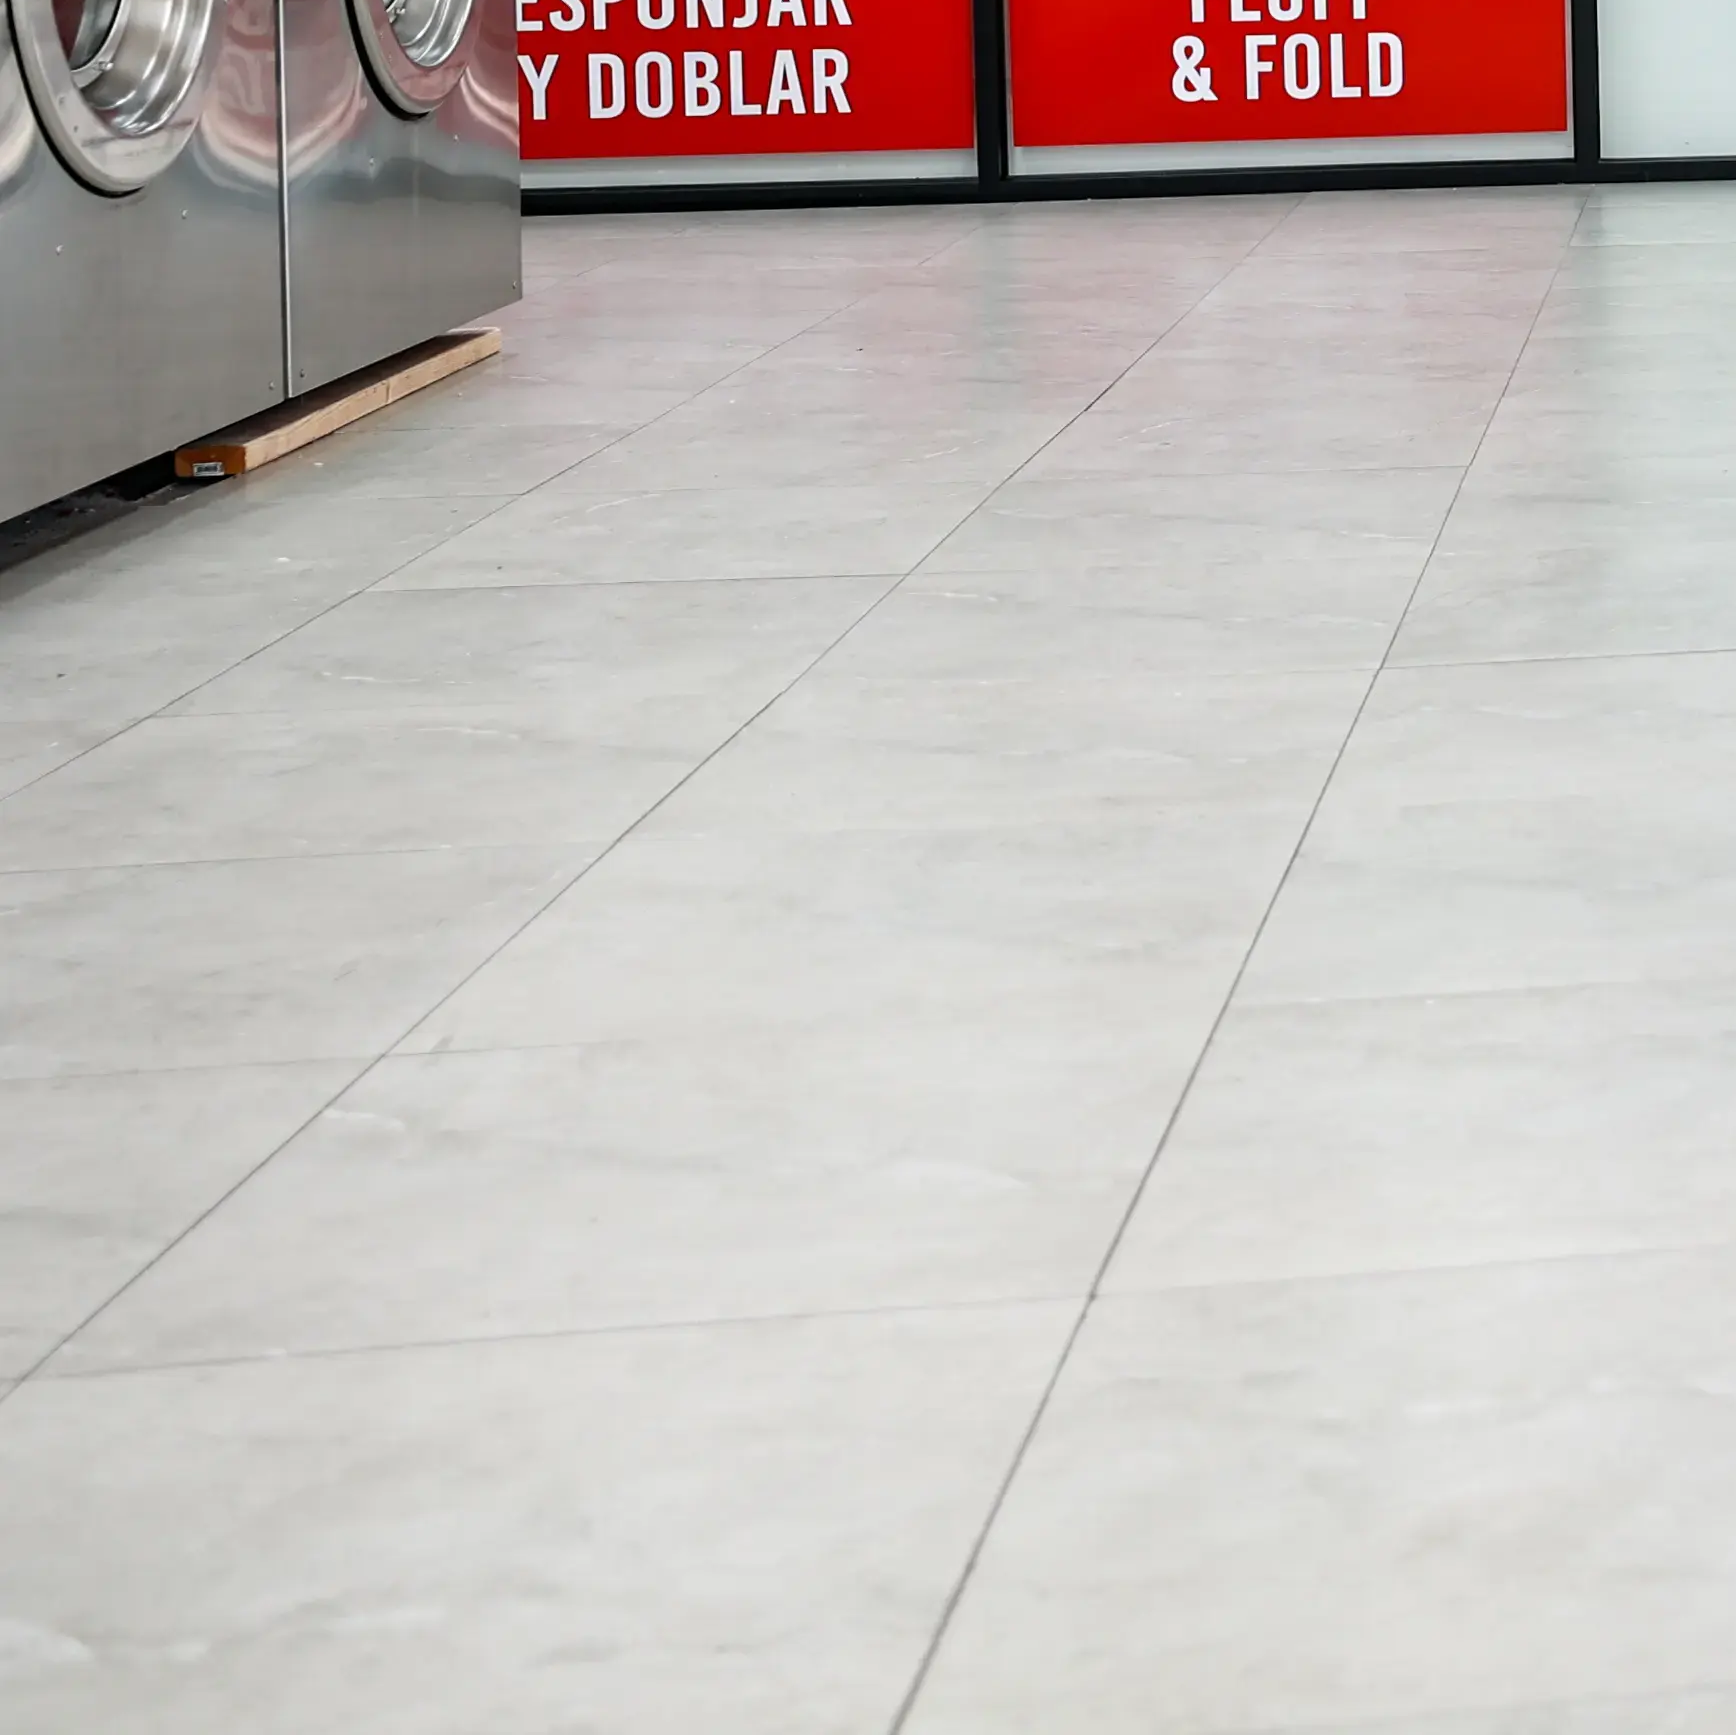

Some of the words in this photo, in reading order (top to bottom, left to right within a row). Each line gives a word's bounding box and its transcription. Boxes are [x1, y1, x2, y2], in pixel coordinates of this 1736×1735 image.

[517, 53, 560, 121] Y
[588, 49, 853, 120] DOBLAR
[1171, 34, 1219, 103] &
[1244, 32, 1405, 100] FOLD
